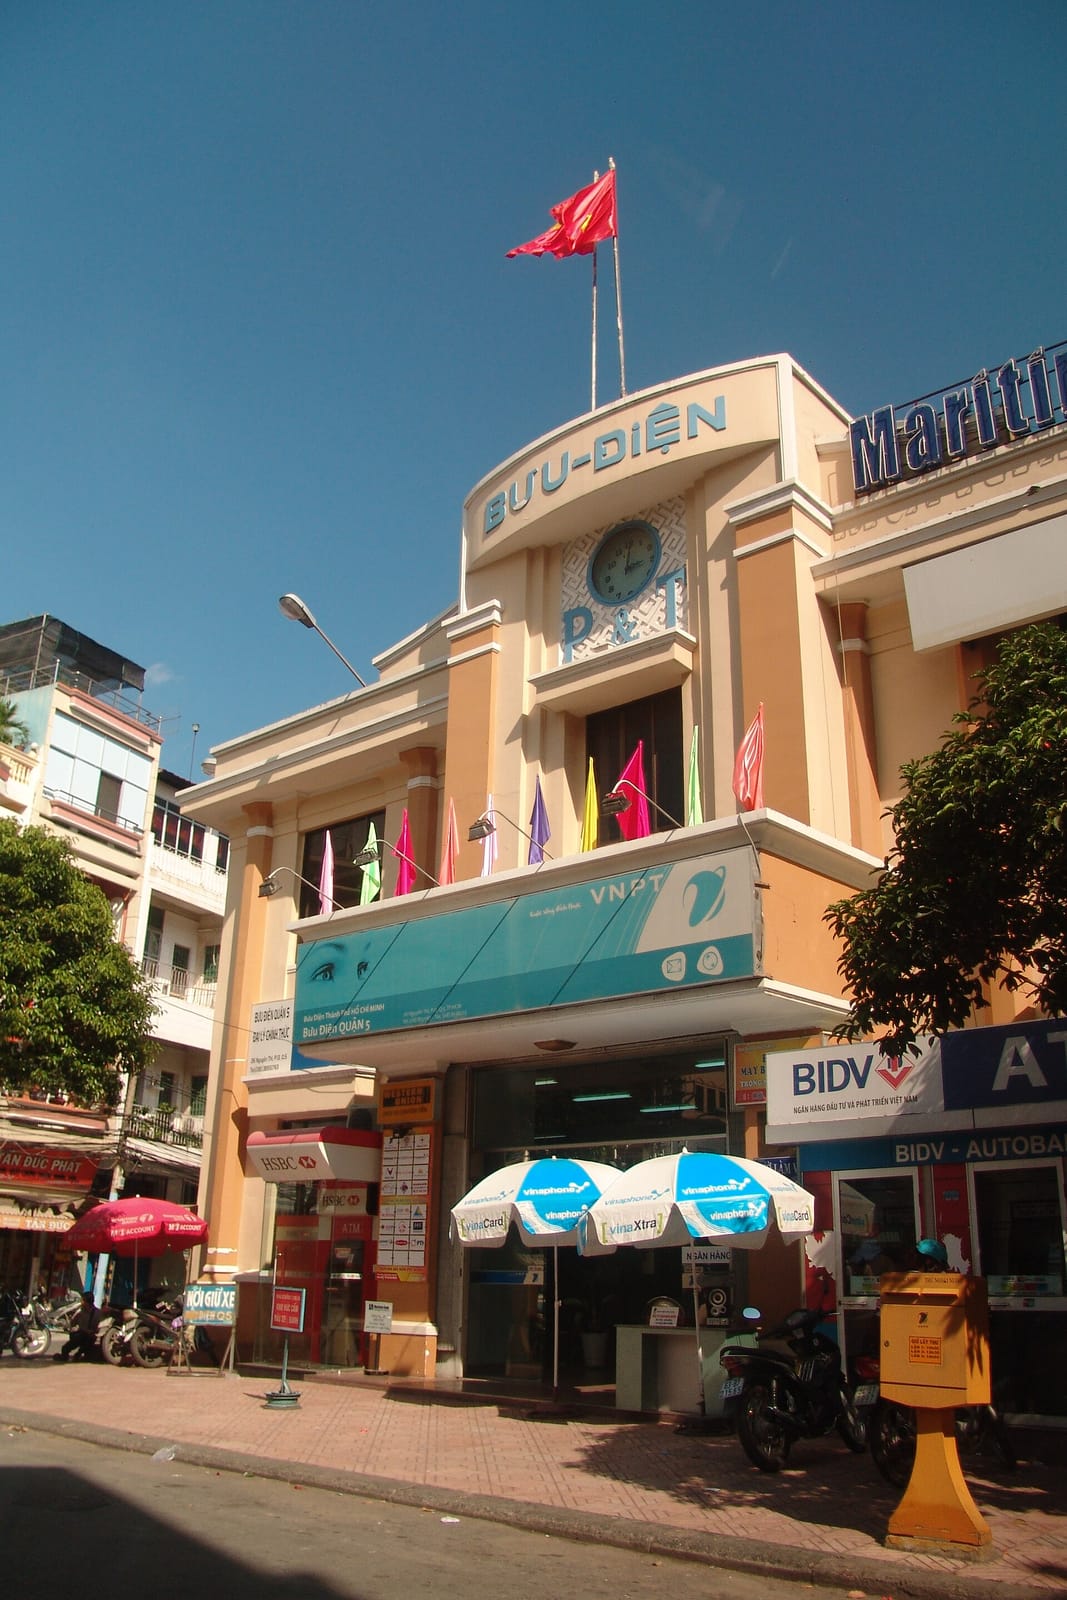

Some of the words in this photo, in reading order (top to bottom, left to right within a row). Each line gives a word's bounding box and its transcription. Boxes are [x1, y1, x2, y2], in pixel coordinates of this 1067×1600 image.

[563, 606, 593, 663] P
[611, 608, 640, 645] &
[656, 567, 687, 629] T
[590, 873, 665, 905] VNPT
[339, 1017, 365, 1034] QUẬN
[365, 1020, 371, 1031] 5
[793, 1055, 874, 1096] BIDV
[903, 1095, 919, 1104] NAM
[895, 1142, 945, 1163] BIDV
[261, 1157, 298, 1171] HSBC
[523, 1183, 576, 1196] vinaphone
[682, 1182, 739, 1197] vinaphone
[222, 1291, 236, 1308] XE
